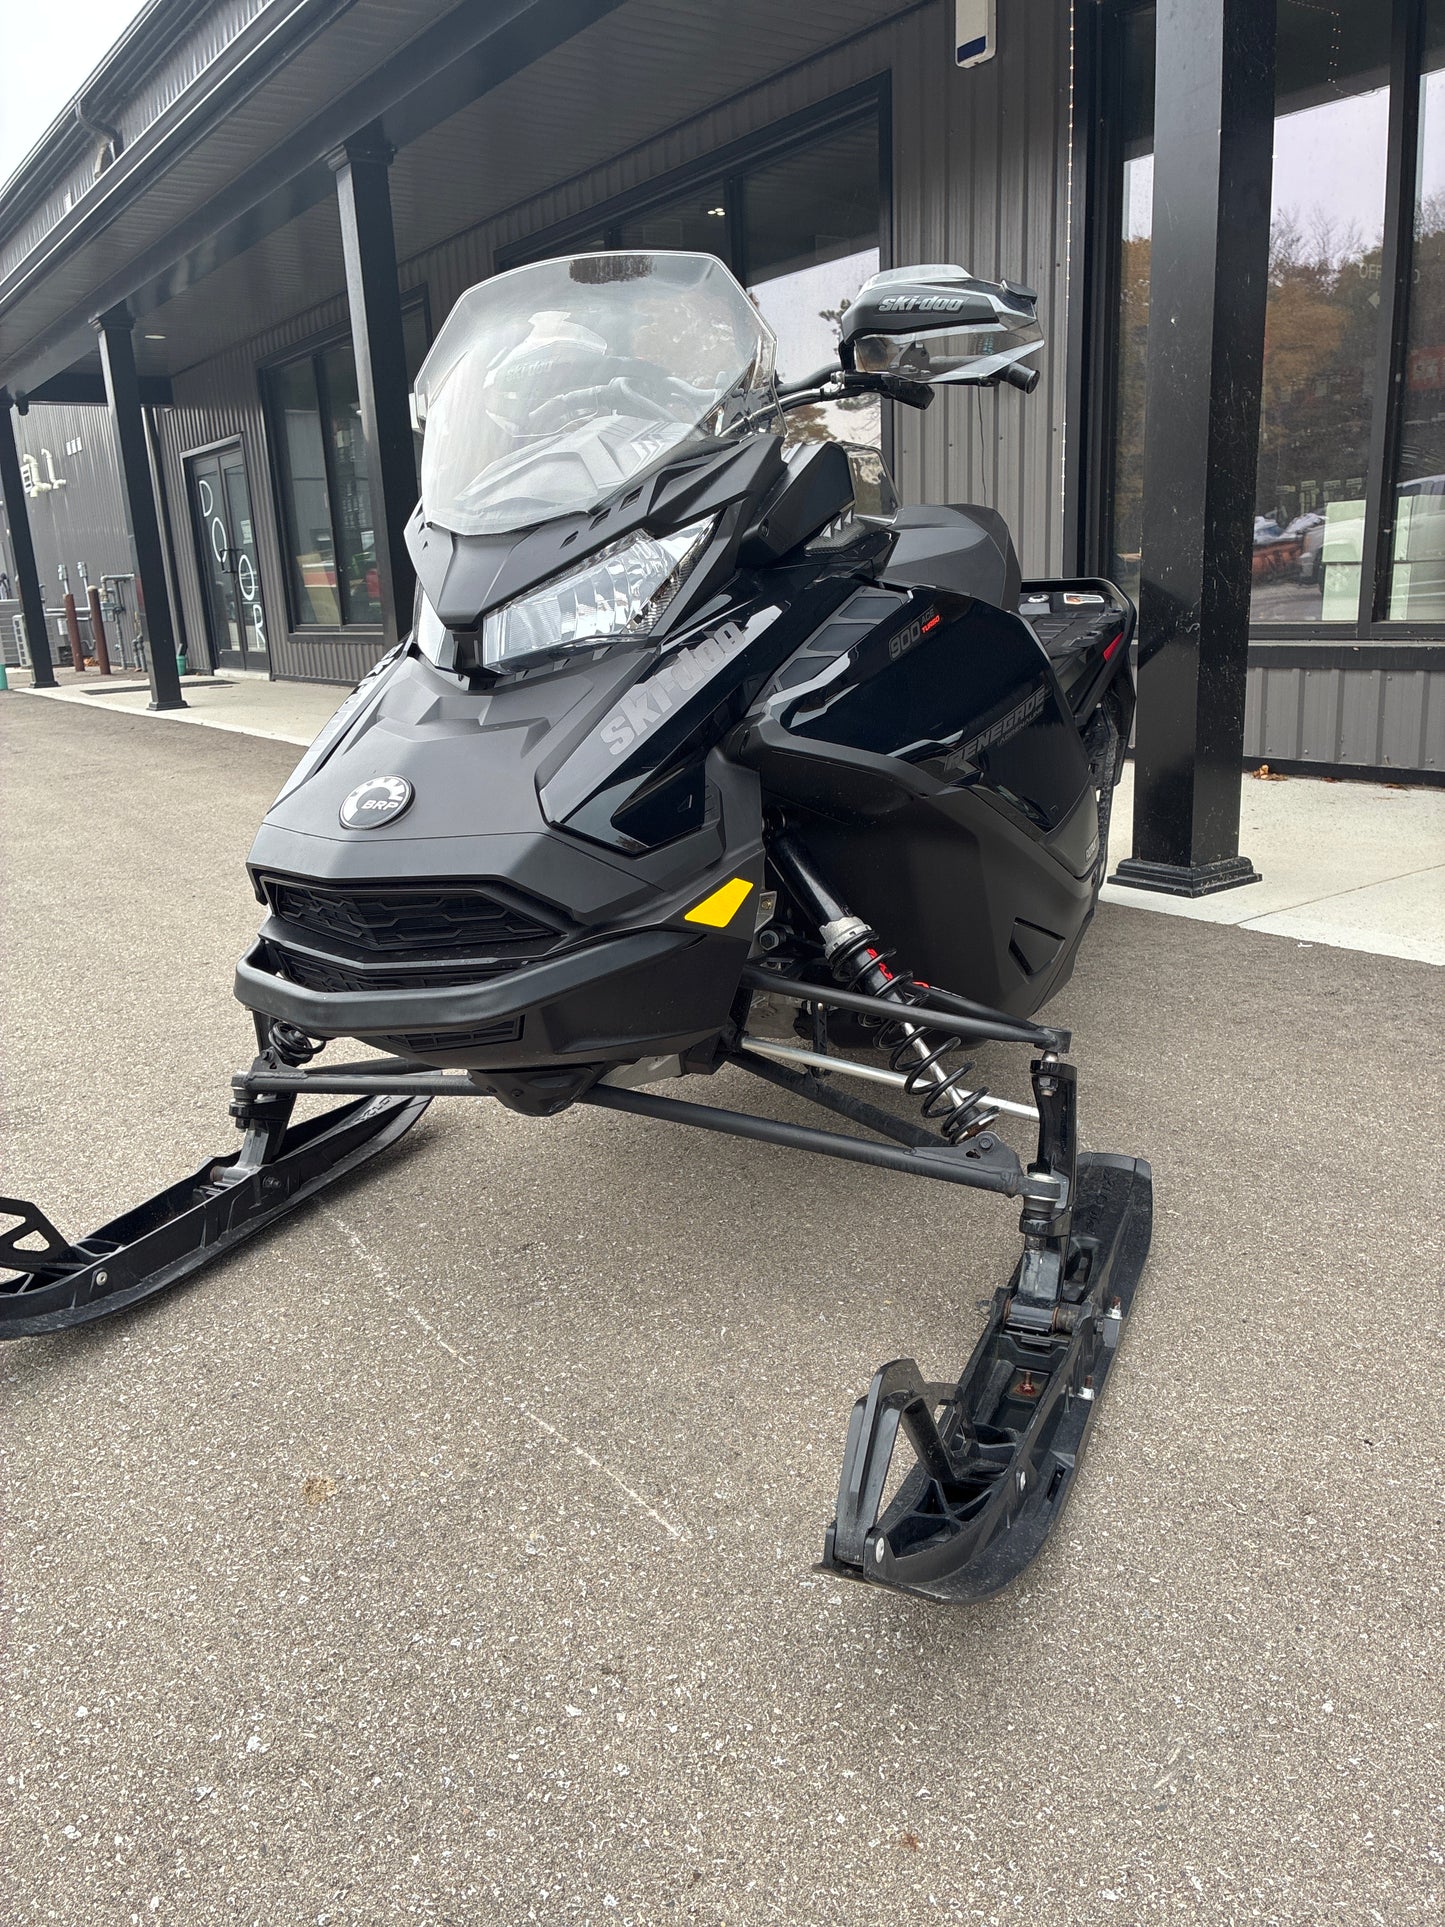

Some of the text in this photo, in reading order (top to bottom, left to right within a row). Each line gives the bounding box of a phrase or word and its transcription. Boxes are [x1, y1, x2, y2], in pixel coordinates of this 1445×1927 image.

[890, 608, 935, 659] 900 ACE
[921, 614, 941, 634] TURBO
[945, 686, 1047, 772] RENEGADE
[361, 799, 400, 811] BRP
